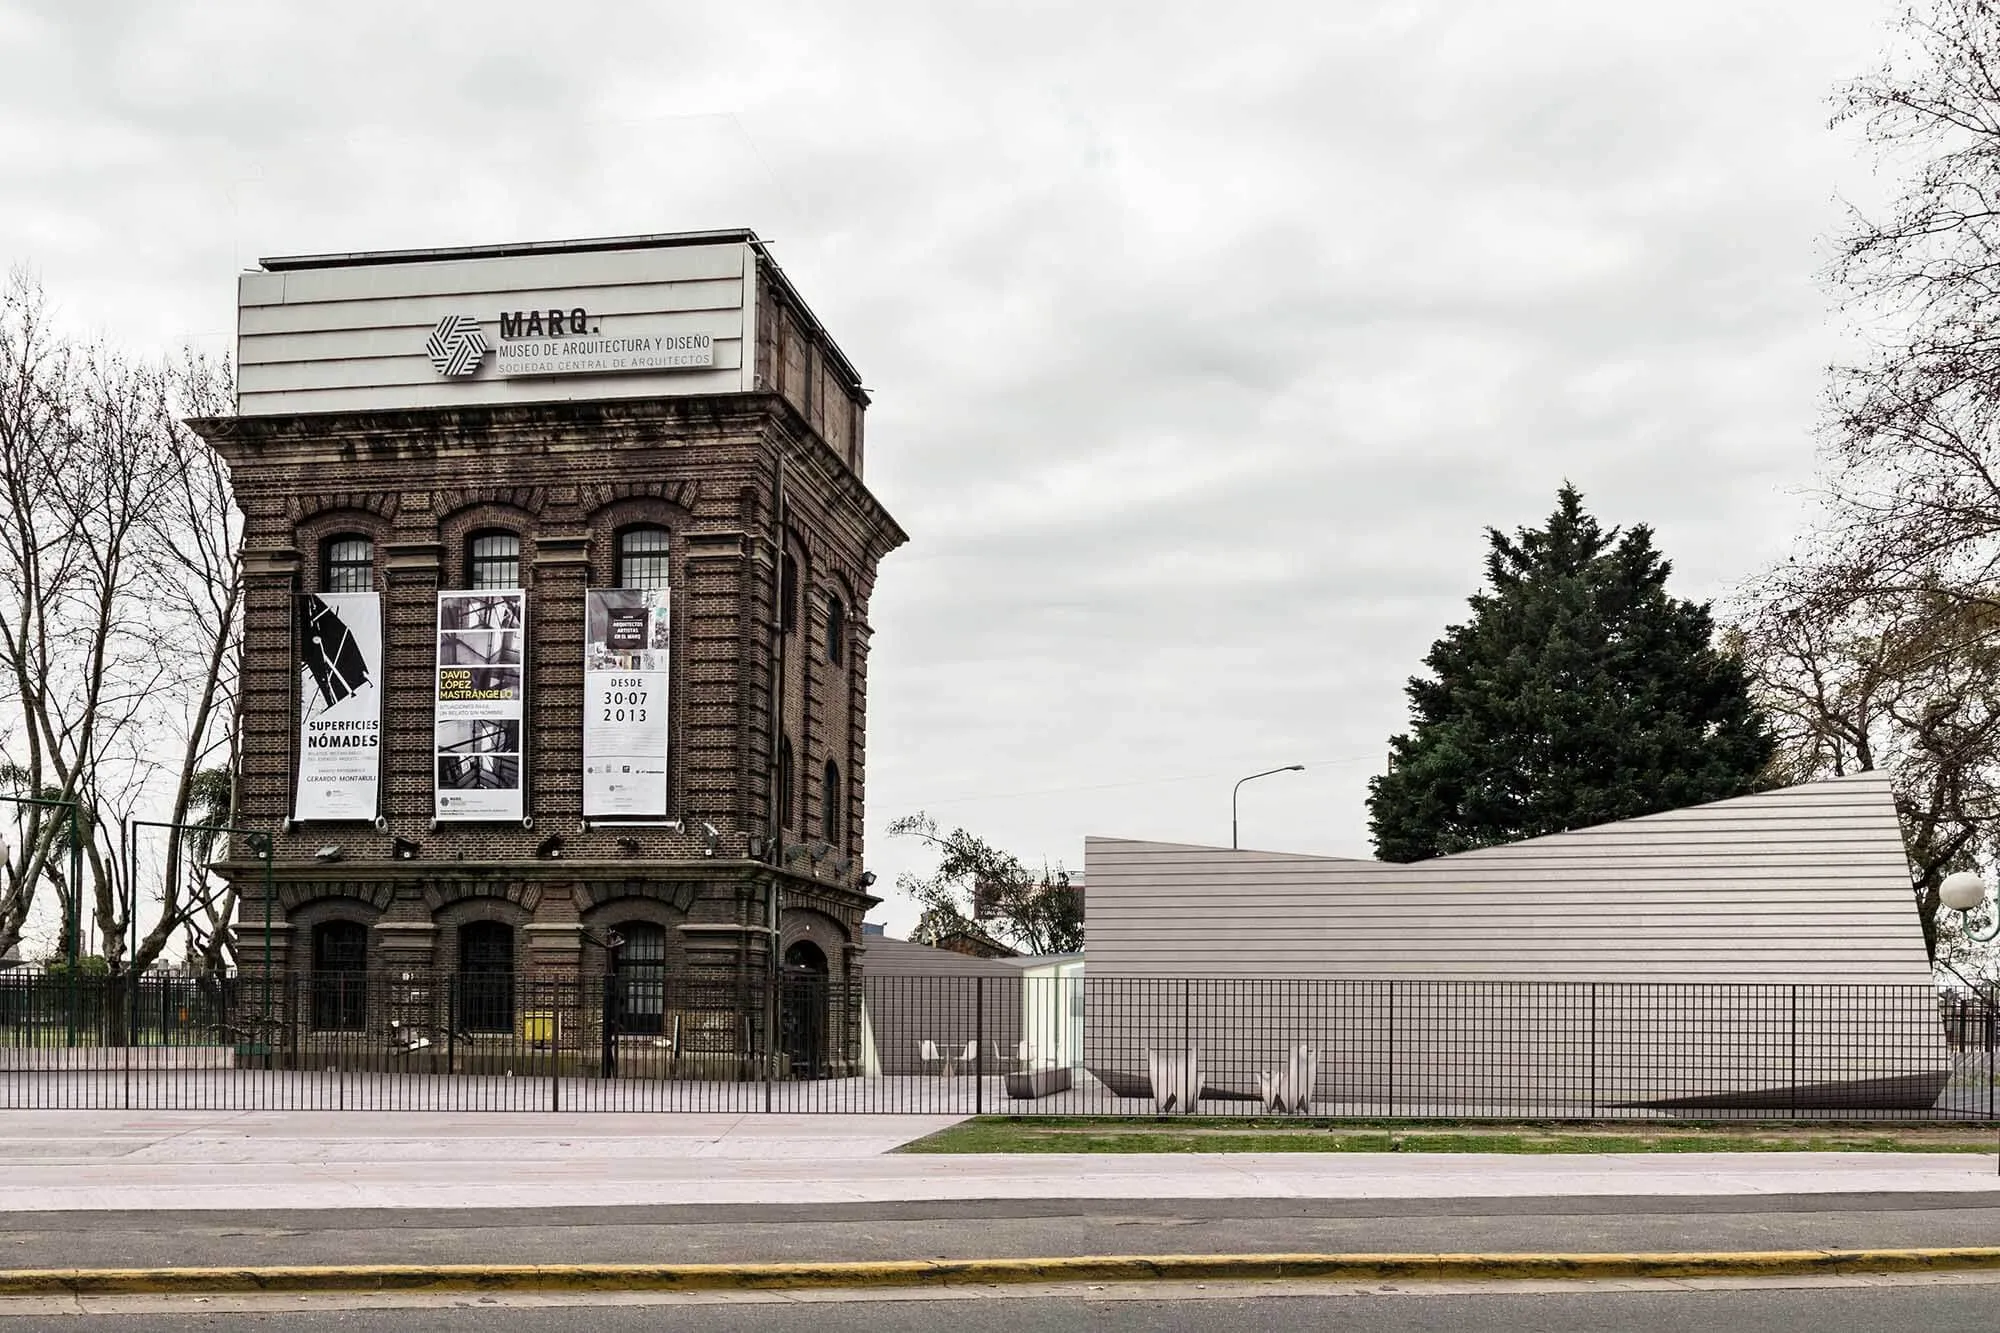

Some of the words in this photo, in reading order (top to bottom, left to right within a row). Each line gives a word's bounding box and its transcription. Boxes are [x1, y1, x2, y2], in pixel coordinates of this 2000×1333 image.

[500, 308, 599, 338] MARQ.
[500, 344, 539, 358] MUSEO
[544, 343, 558, 356] DE
[563, 338, 650, 355] ARQUITECTURA
[655, 338, 662, 350] Y
[666, 334, 710, 350] DISEÑO
[499, 362, 553, 373] SOCIEDAD
[558, 360, 607, 371] CENTRAL
[613, 359, 626, 368] DE
[631, 355, 709, 367] ARQUITECTOS
[440, 670, 471, 679] DAVID
[440, 679, 472, 689] LÓPEZ
[611, 678, 642, 687] DESDE
[604, 709, 646, 721] 2013
[309, 720, 378, 731] SUPERFICIES
[308, 733, 378, 748] NÓMADES
